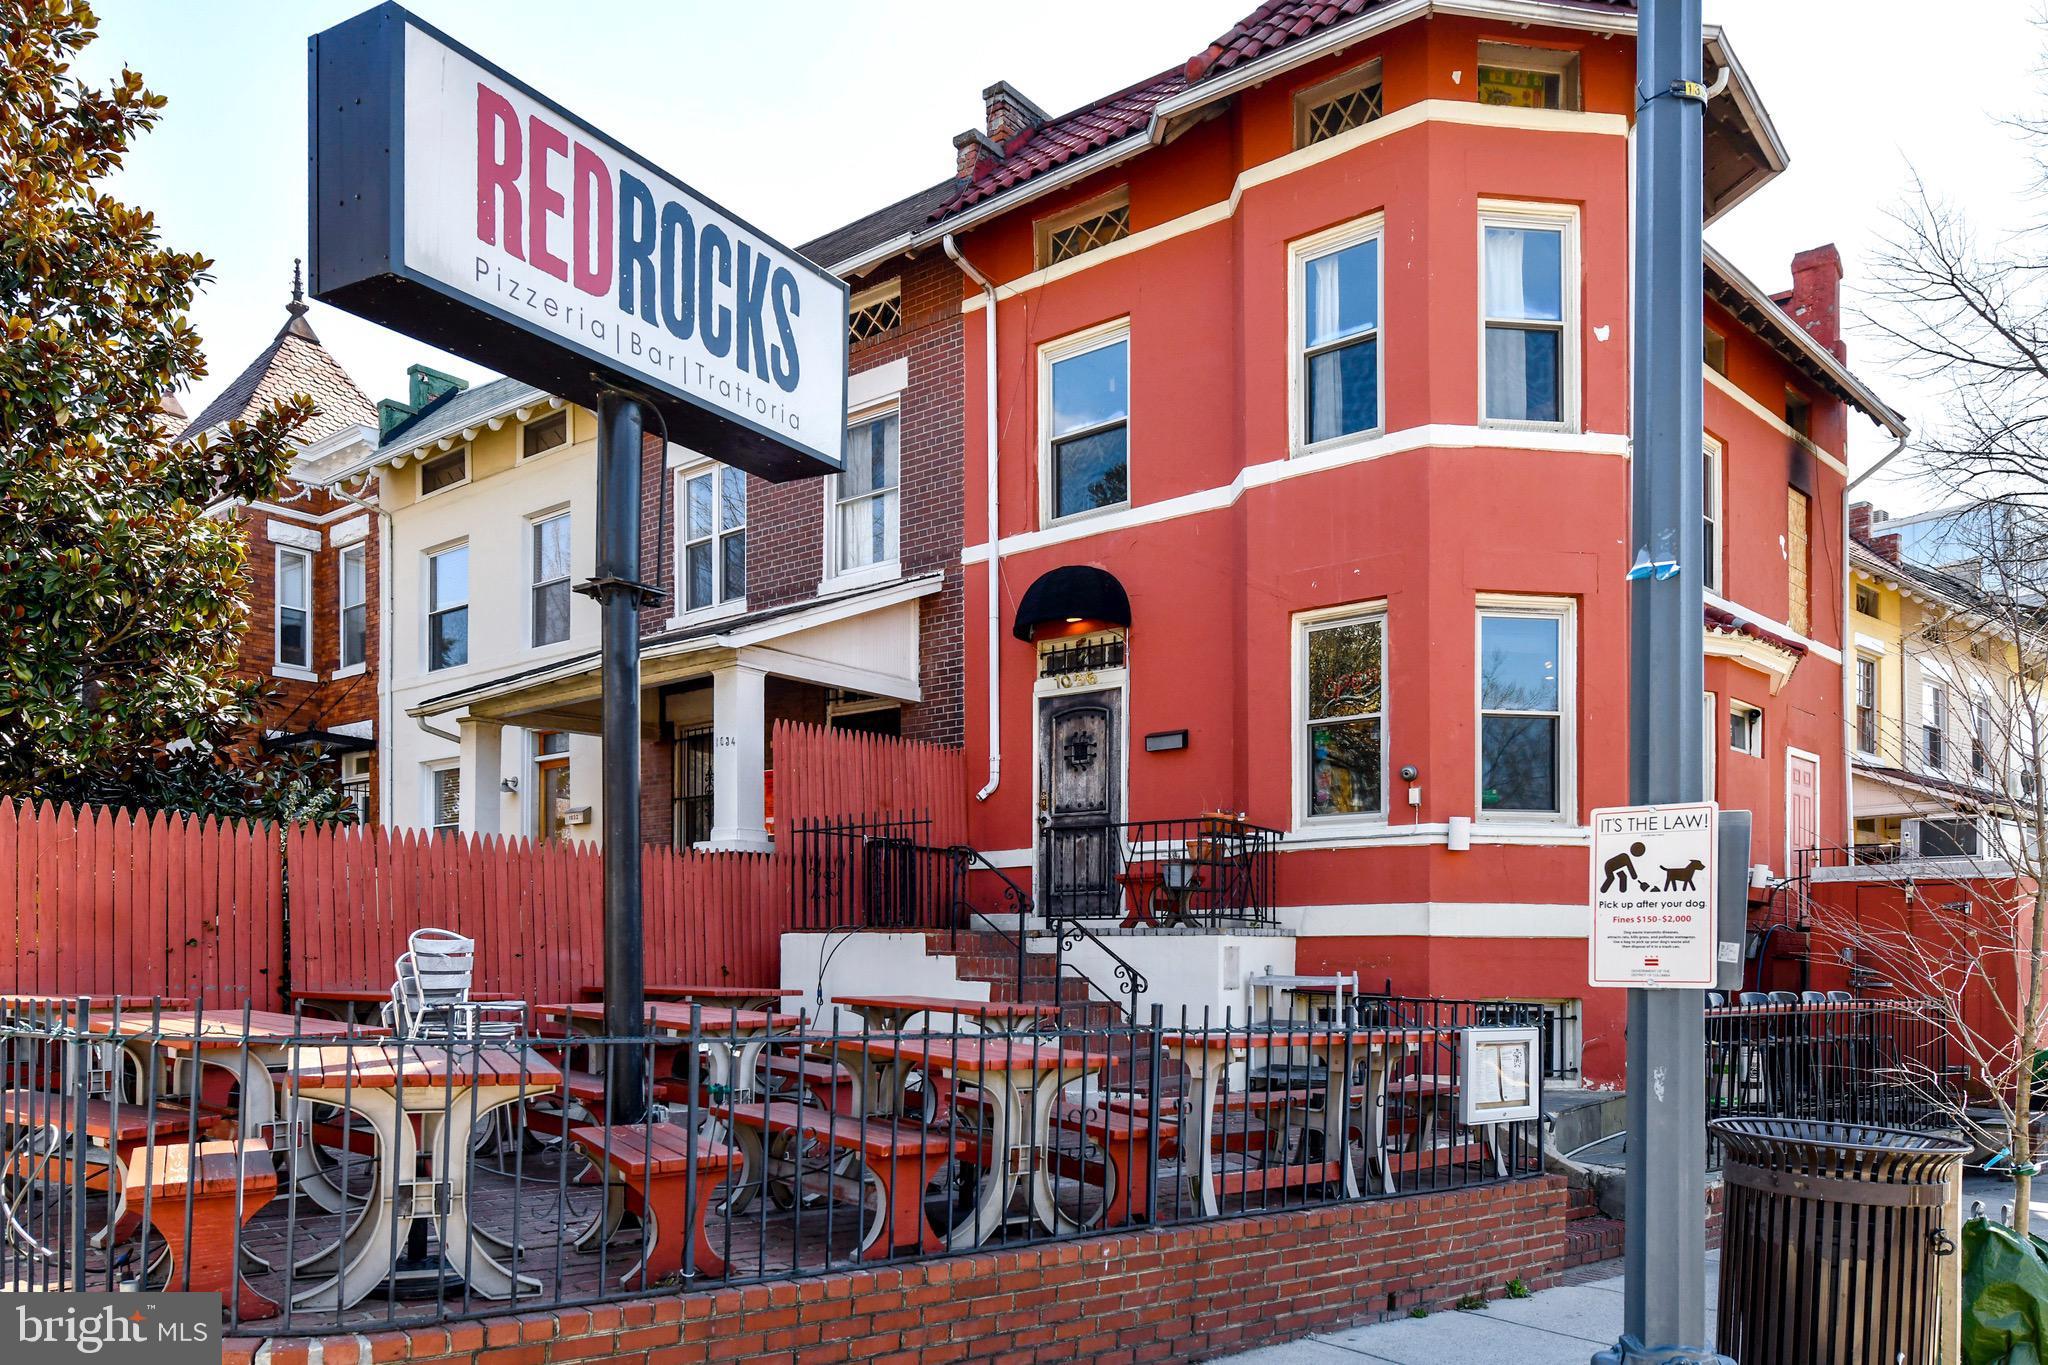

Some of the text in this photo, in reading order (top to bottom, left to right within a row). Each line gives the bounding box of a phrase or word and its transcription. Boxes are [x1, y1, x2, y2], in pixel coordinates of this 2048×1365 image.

[475, 256, 605, 340] Pizzeria
[631, 331, 674, 371] Bar
[695, 362, 800, 430] Trattoria
[1600, 814, 1708, 833] IT'S THE LAW!
[1599, 900, 1618, 909] Pick
[1621, 901, 1634, 910] up
[1636, 900, 1658, 908] after
[1661, 901, 1683, 910] your
